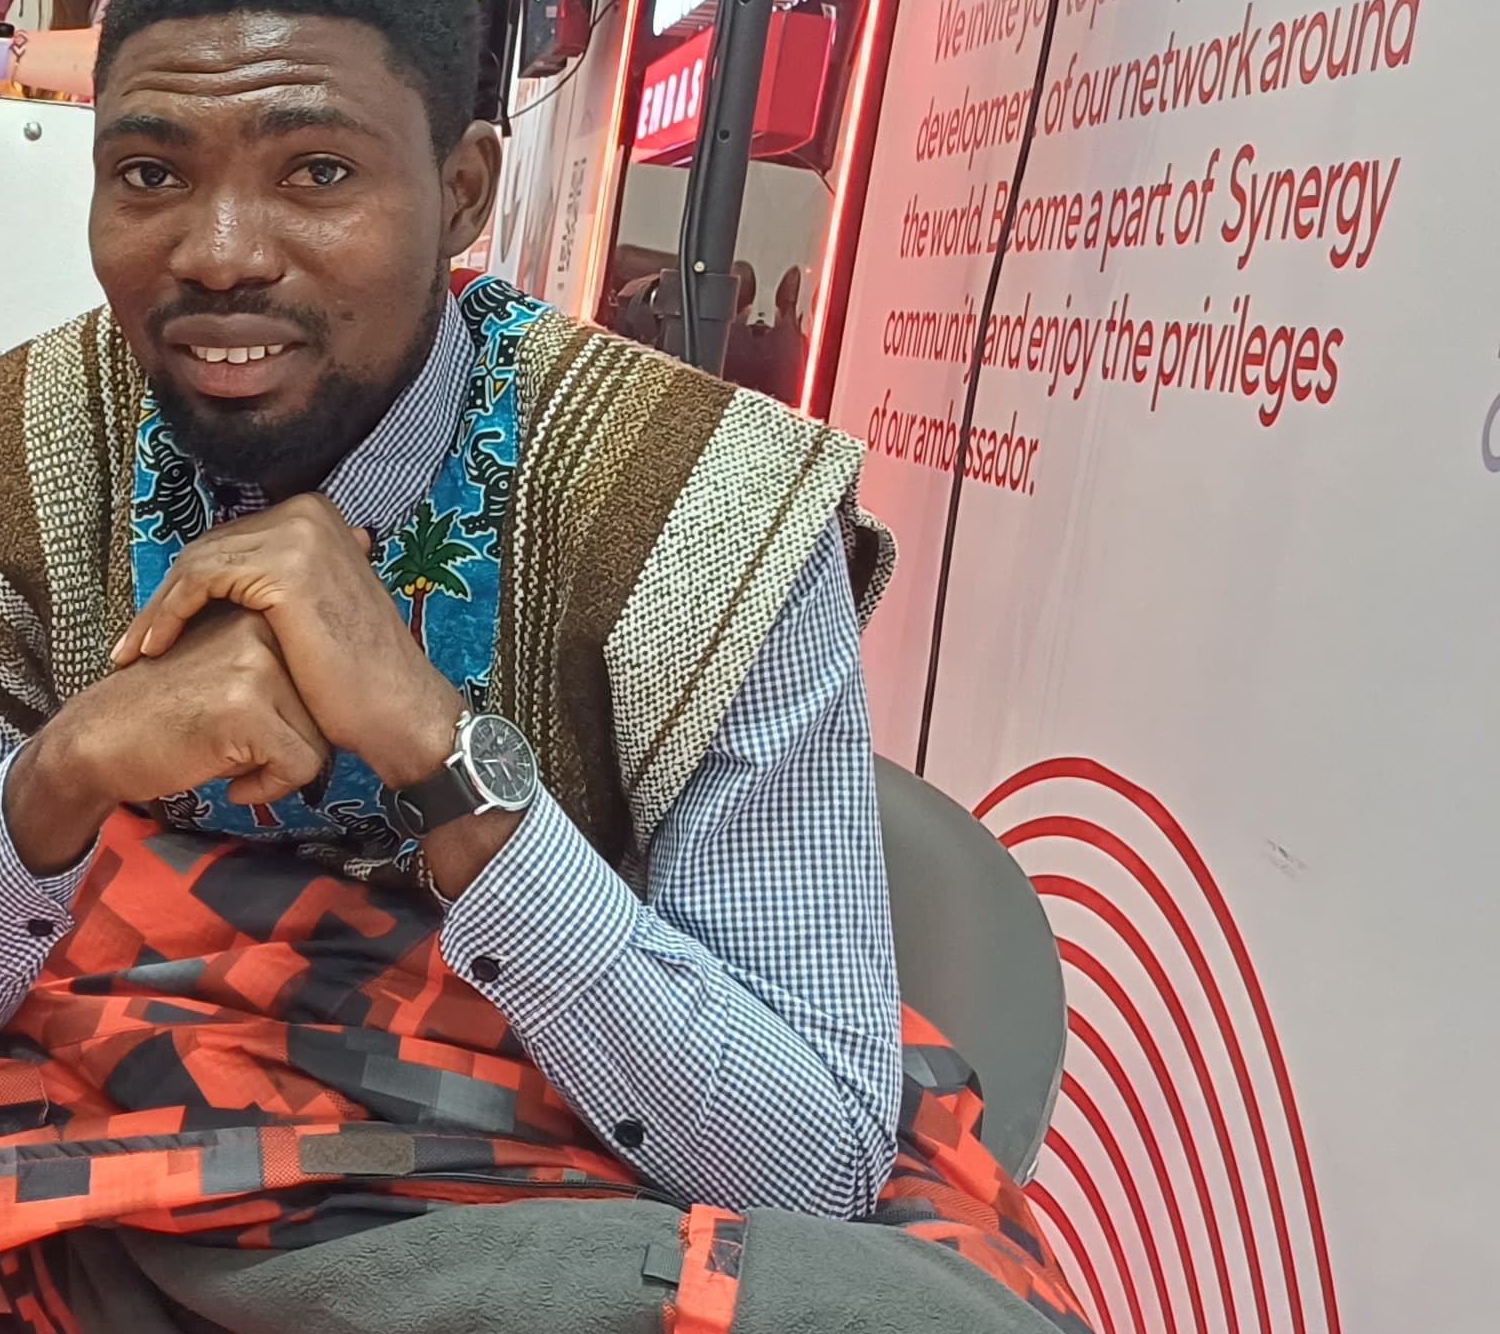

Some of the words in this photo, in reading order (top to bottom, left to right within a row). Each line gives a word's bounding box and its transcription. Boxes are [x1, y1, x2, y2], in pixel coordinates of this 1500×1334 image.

[916, 85, 1037, 171] developmen
[1044, 52, 1078, 136] of
[1072, 63, 1122, 130] our
[1118, 3, 1270, 121] network
[900, 193, 930, 259] the
[930, 182, 988, 257] world.
[986, 180, 1083, 253] Bcome
[1084, 190, 1103, 250] a
[1100, 162, 1173, 272] part
[1174, 148, 1221, 244] of
[1221, 143, 1401, 269] Synergy
[981, 292, 1031, 369] and
[1027, 293, 1102, 401] enjoy
[1101, 293, 1153, 383] the
[1151, 294, 1345, 428] privileges
[868, 388, 891, 452] of
[886, 410, 917, 460] our
[913, 399, 1039, 496] ambssador.
